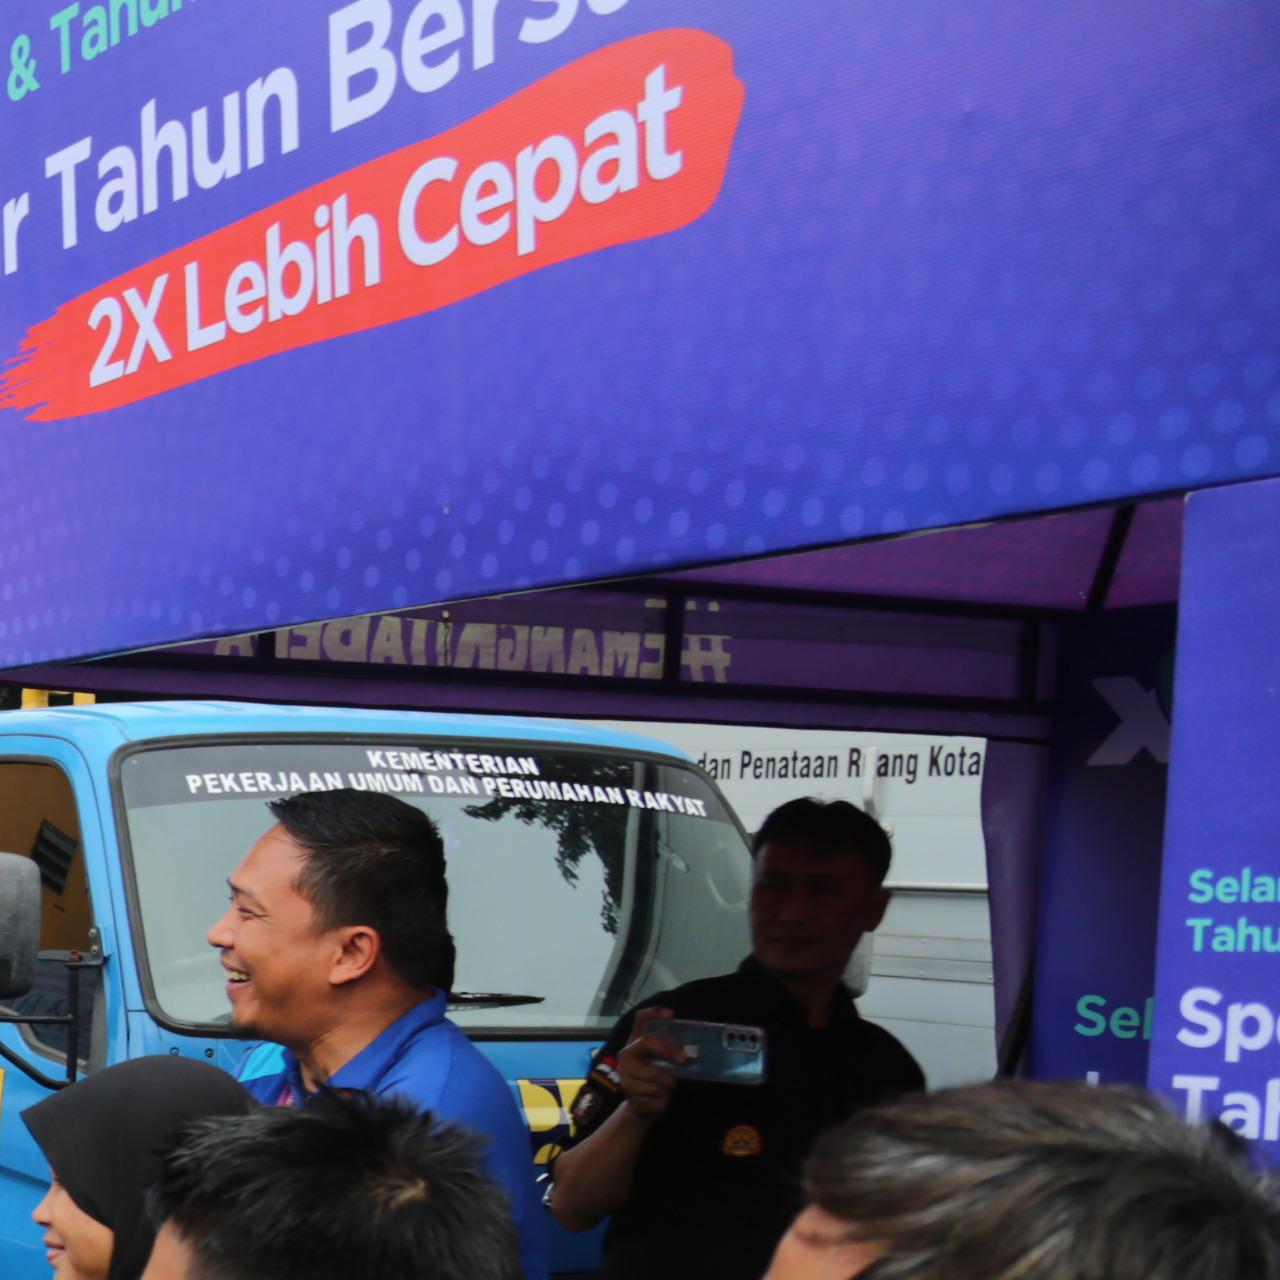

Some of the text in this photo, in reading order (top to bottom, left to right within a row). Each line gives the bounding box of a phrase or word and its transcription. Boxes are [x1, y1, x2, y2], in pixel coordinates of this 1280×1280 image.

[6, 34, 40, 101] &
[49, 0, 183, 74] Tahu
[44, 66, 299, 250] Tahun
[328, 0, 632, 134] Ber
[87, 64, 683, 388] 2X Lebih Cepat
[366, 750, 539, 776] KEMENTERIAN
[697, 745, 981, 784] dan Penataan Rang Kota
[185, 771, 707, 817] PEKERJAAN UMUM DAN PERUMAHAN RAKYAT
[1188, 866, 1280, 904] Sela
[1176, 987, 1280, 1063] Sp
